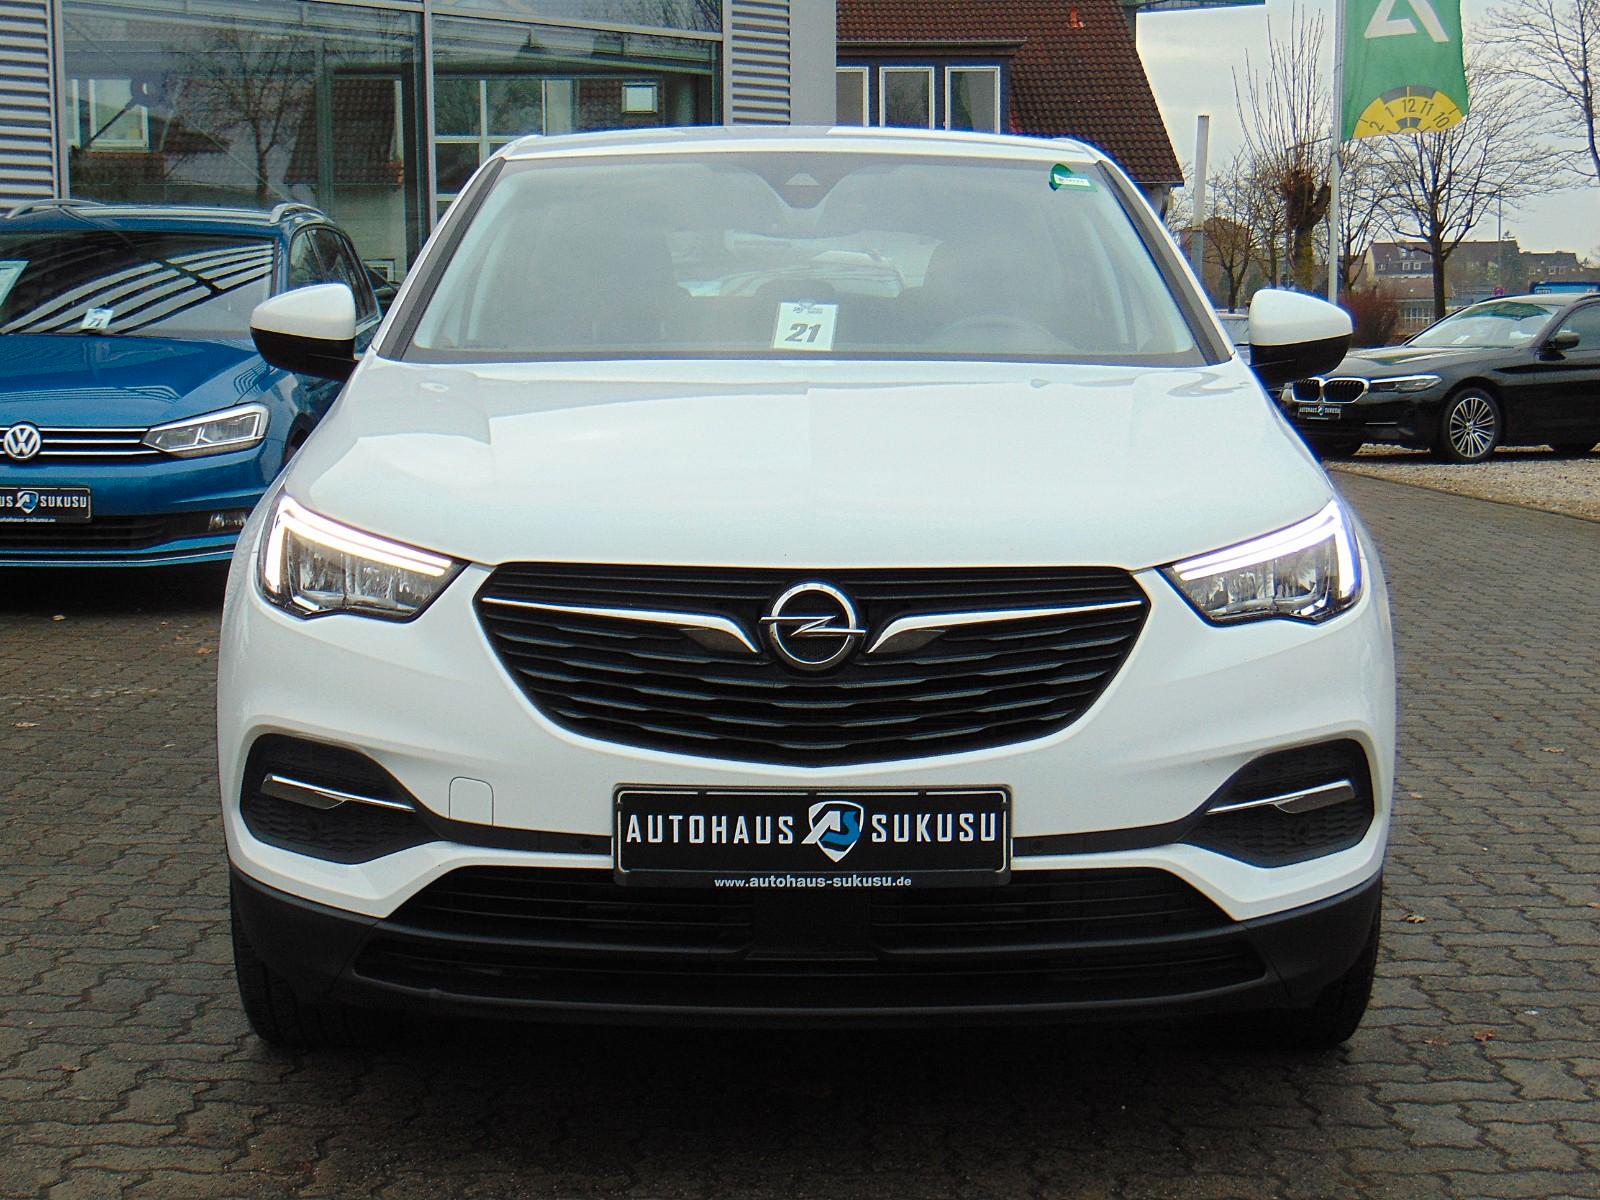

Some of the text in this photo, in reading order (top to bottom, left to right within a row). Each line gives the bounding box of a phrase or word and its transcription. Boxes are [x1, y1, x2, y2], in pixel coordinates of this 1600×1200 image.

[1385, 105, 1395, 118] 1
[1402, 98, 1416, 113] 12
[1420, 100, 1434, 116] 11
[1432, 111, 1450, 129] 10
[784, 323, 822, 343] 21
[40, 495, 87, 508] SUKUSU
[626, 814, 794, 845] AUTOHAUS
[871, 812, 996, 843] SUKUSU
[714, 874, 912, 888] www.autohaus-sukusu.de
